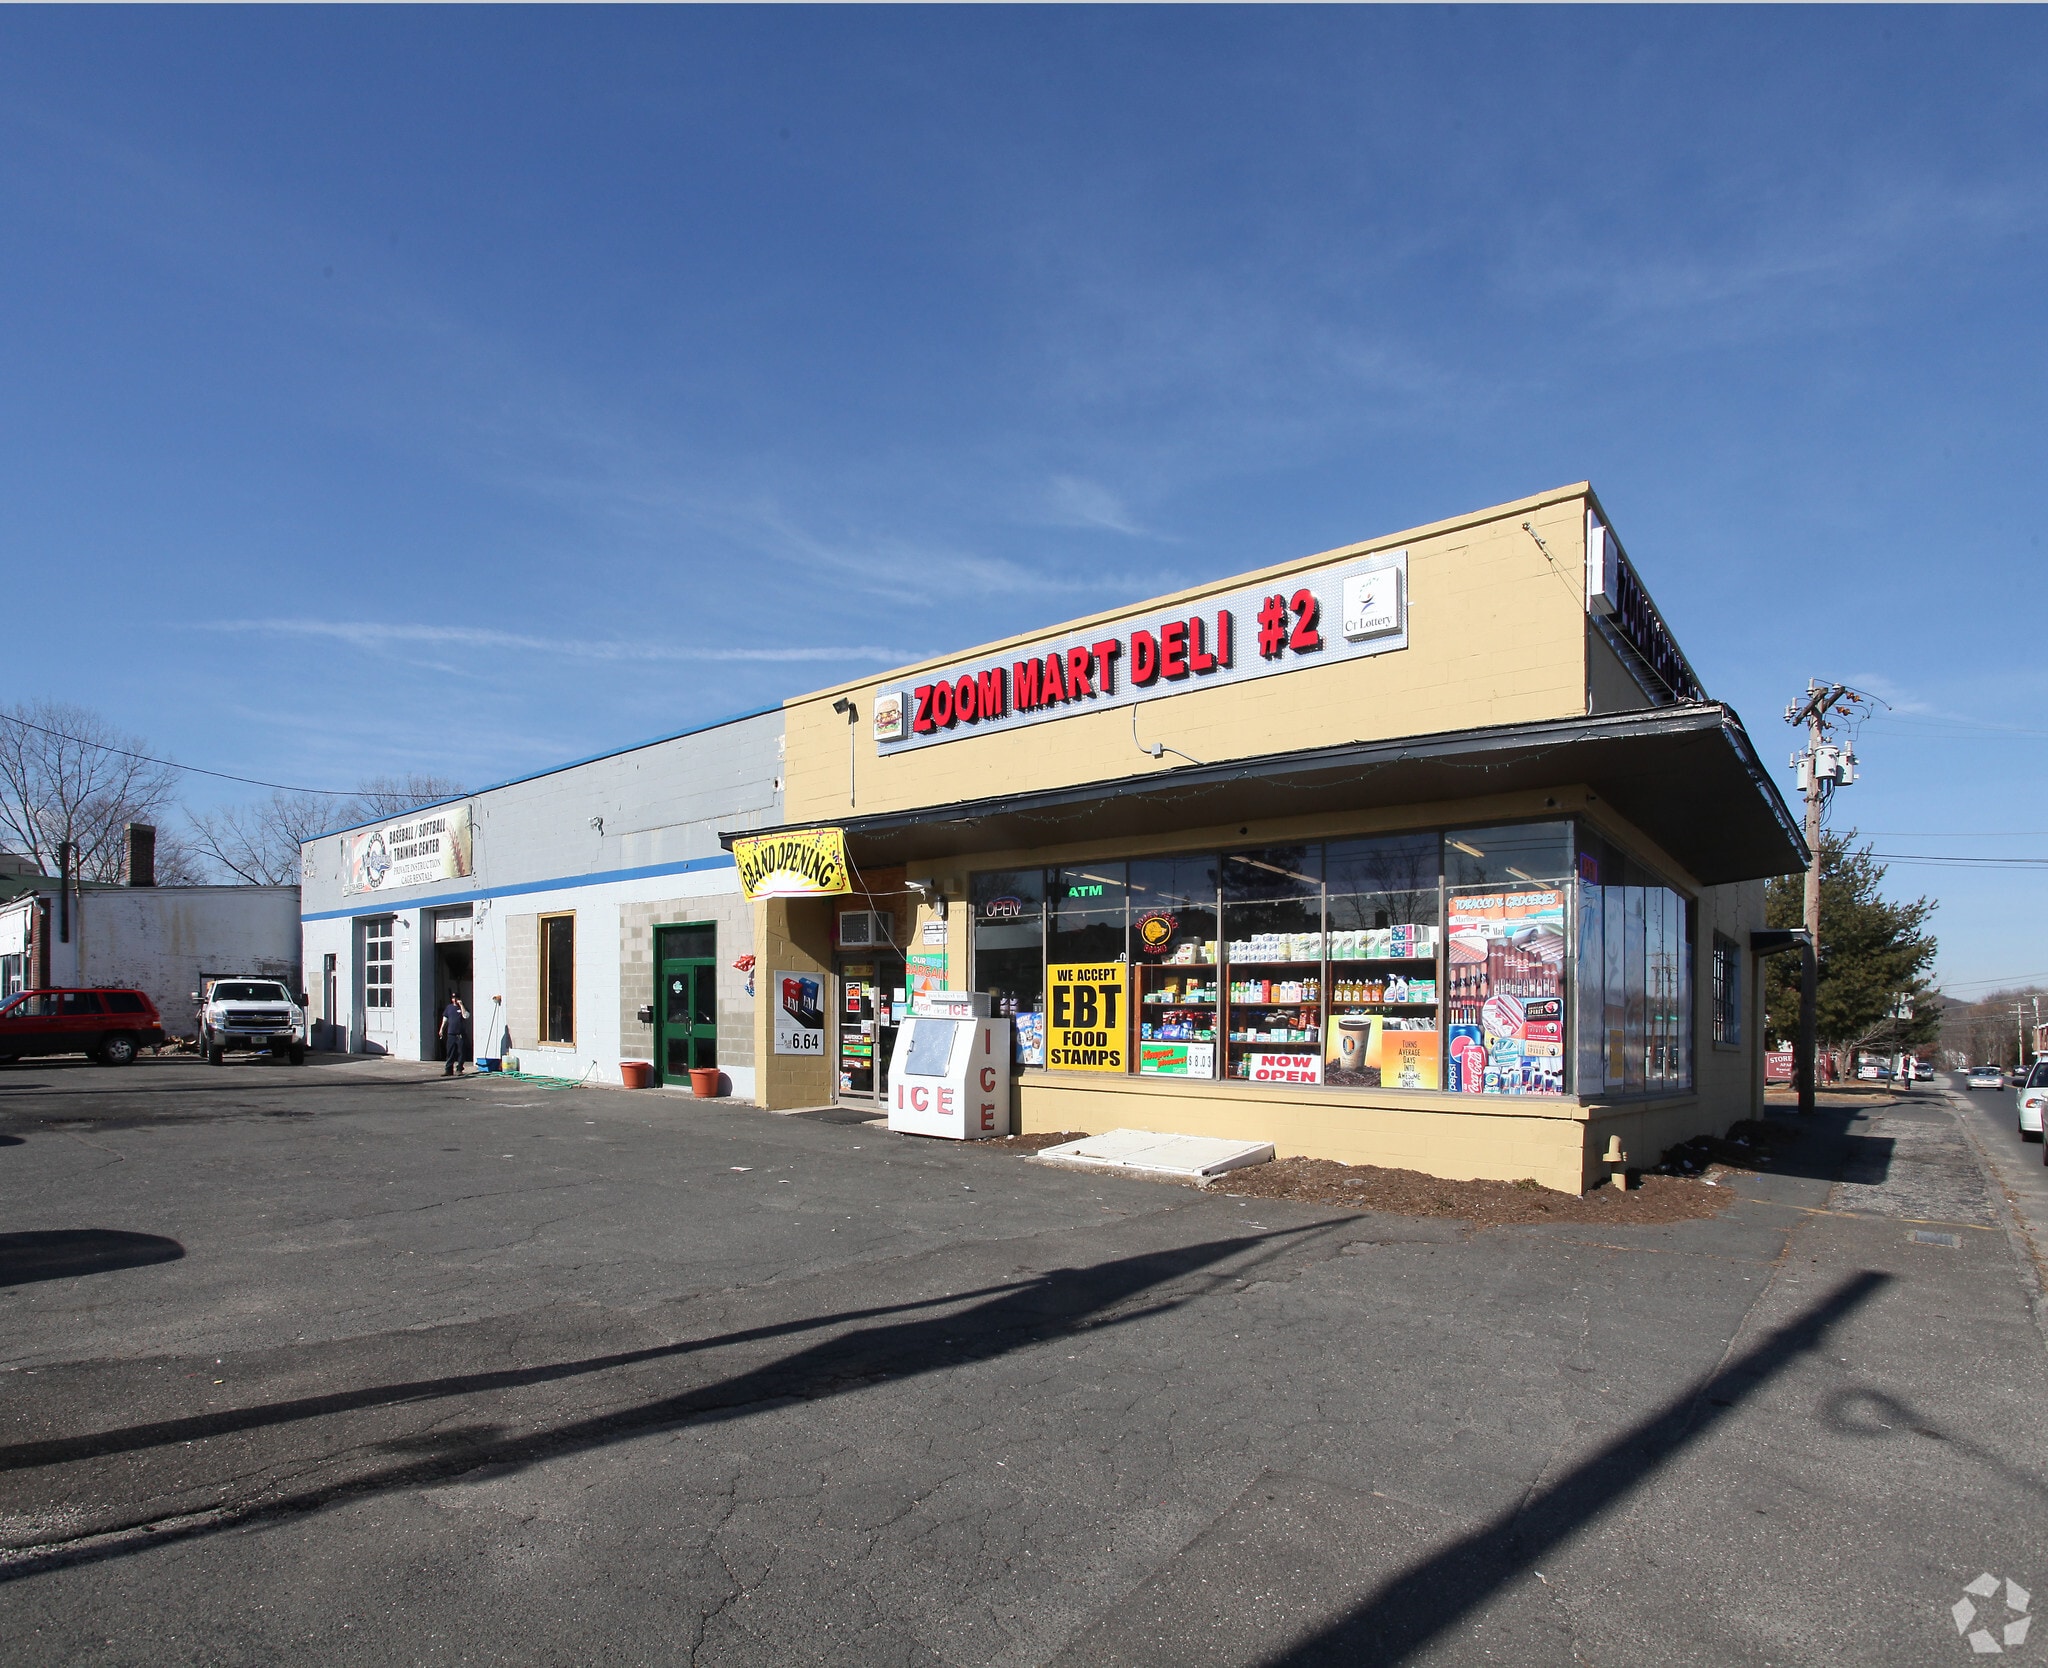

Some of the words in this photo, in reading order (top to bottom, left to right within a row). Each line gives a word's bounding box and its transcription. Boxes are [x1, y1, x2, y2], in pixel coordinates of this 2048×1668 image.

[1360, 616, 1392, 629] Lottery
[912, 667, 1006, 734] ZOOM
[1012, 638, 1121, 711] MART
[1130, 609, 1231, 685] DELI
[1257, 588, 1321, 658] #2
[389, 824, 414, 845] BASEBALL
[419, 818, 446, 838] SOFTBALL
[394, 843, 417, 861] TRAINING
[418, 838, 440, 856] CENTER
[410, 859, 441, 872] INSTRUCTION
[742, 845, 776, 893] GRAND
[777, 842, 835, 887] OPENING
[1069, 884, 1103, 897] ATM
[986, 901, 1019, 917] OPEN
[1455, 897, 1495, 911] TOBACCO
[1506, 892, 1557, 909] GROCERIES
[912, 956, 926, 965] OUR
[1057, 969, 1073, 981] WE
[1077, 968, 1117, 981] ACCEPT
[949, 1004, 969, 1015] ICE
[1053, 984, 1122, 1028] EBT
[792, 1033, 819, 1050] 6.64
[1063, 1031, 1108, 1047] FOOD
[1051, 1048, 1121, 1067] STAMPS
[1398, 1048, 1421, 1056] AVERAGE
[1261, 1055, 1313, 1068] NOW
[980, 1028, 996, 1131] ICE
[1255, 1069, 1317, 1083] OPEN
[1449, 1063, 1458, 1091] pepsi
[898, 1084, 954, 1115] ICE
